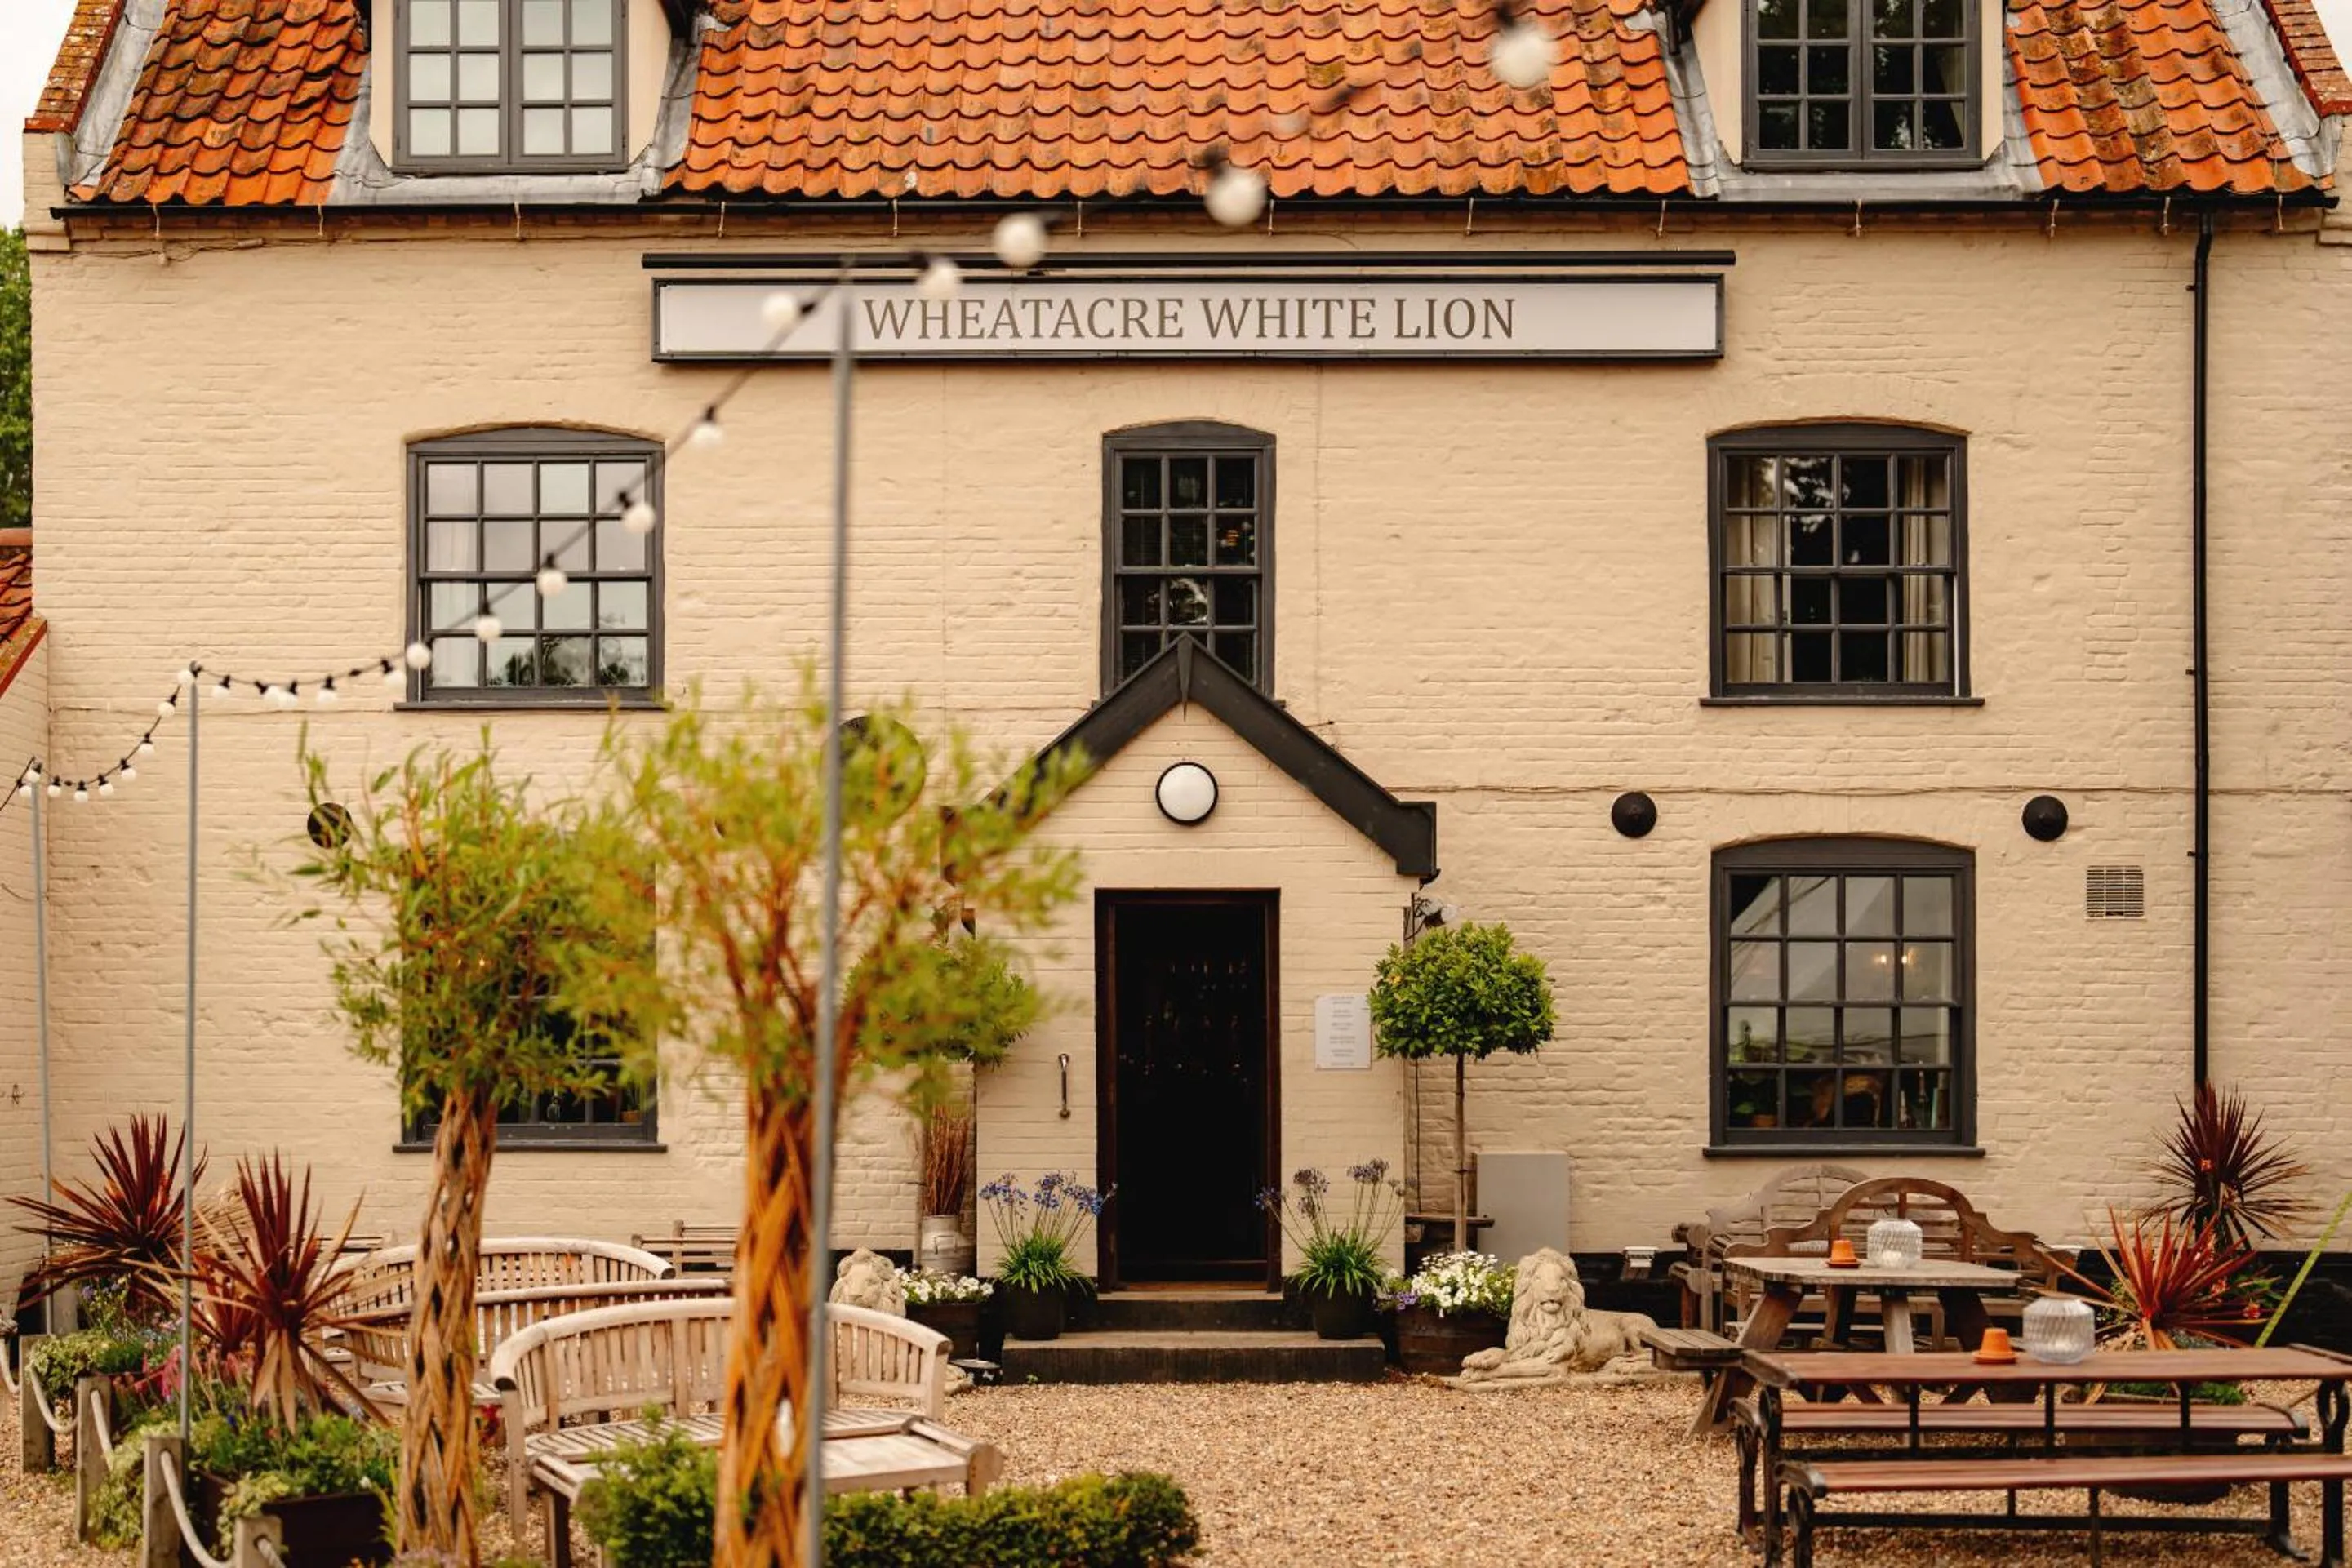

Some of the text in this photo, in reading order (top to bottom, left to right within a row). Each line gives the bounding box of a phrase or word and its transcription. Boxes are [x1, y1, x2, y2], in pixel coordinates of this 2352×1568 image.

[863, 298, 1516, 340] WHEATACRE WHITE LION
